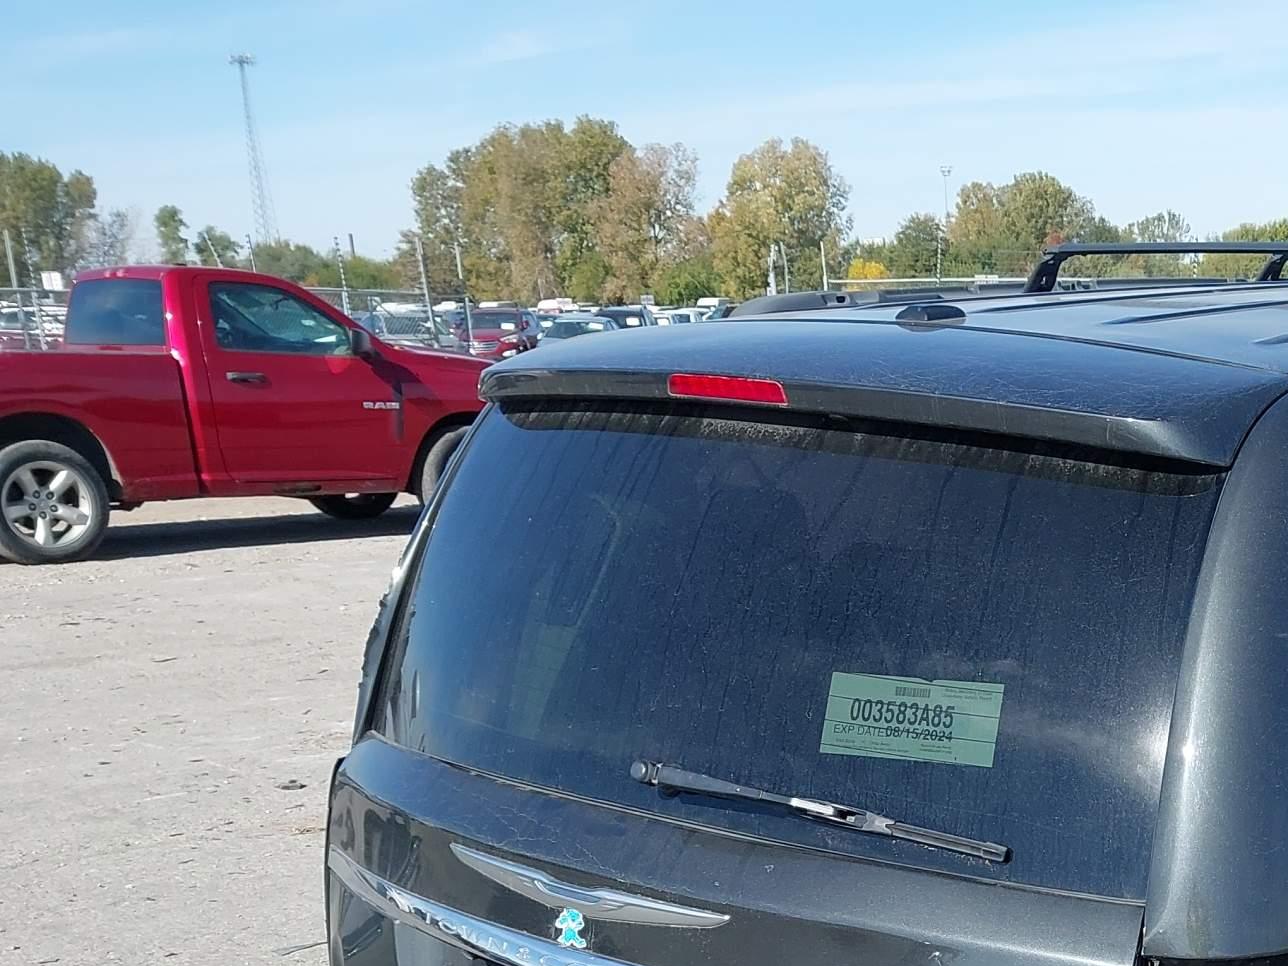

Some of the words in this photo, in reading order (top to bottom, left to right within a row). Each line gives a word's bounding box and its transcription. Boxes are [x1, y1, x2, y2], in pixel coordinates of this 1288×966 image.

[362, 401, 400, 409] RAM
[850, 698, 955, 728] 003583A85
[833, 723, 855, 735] EXP
